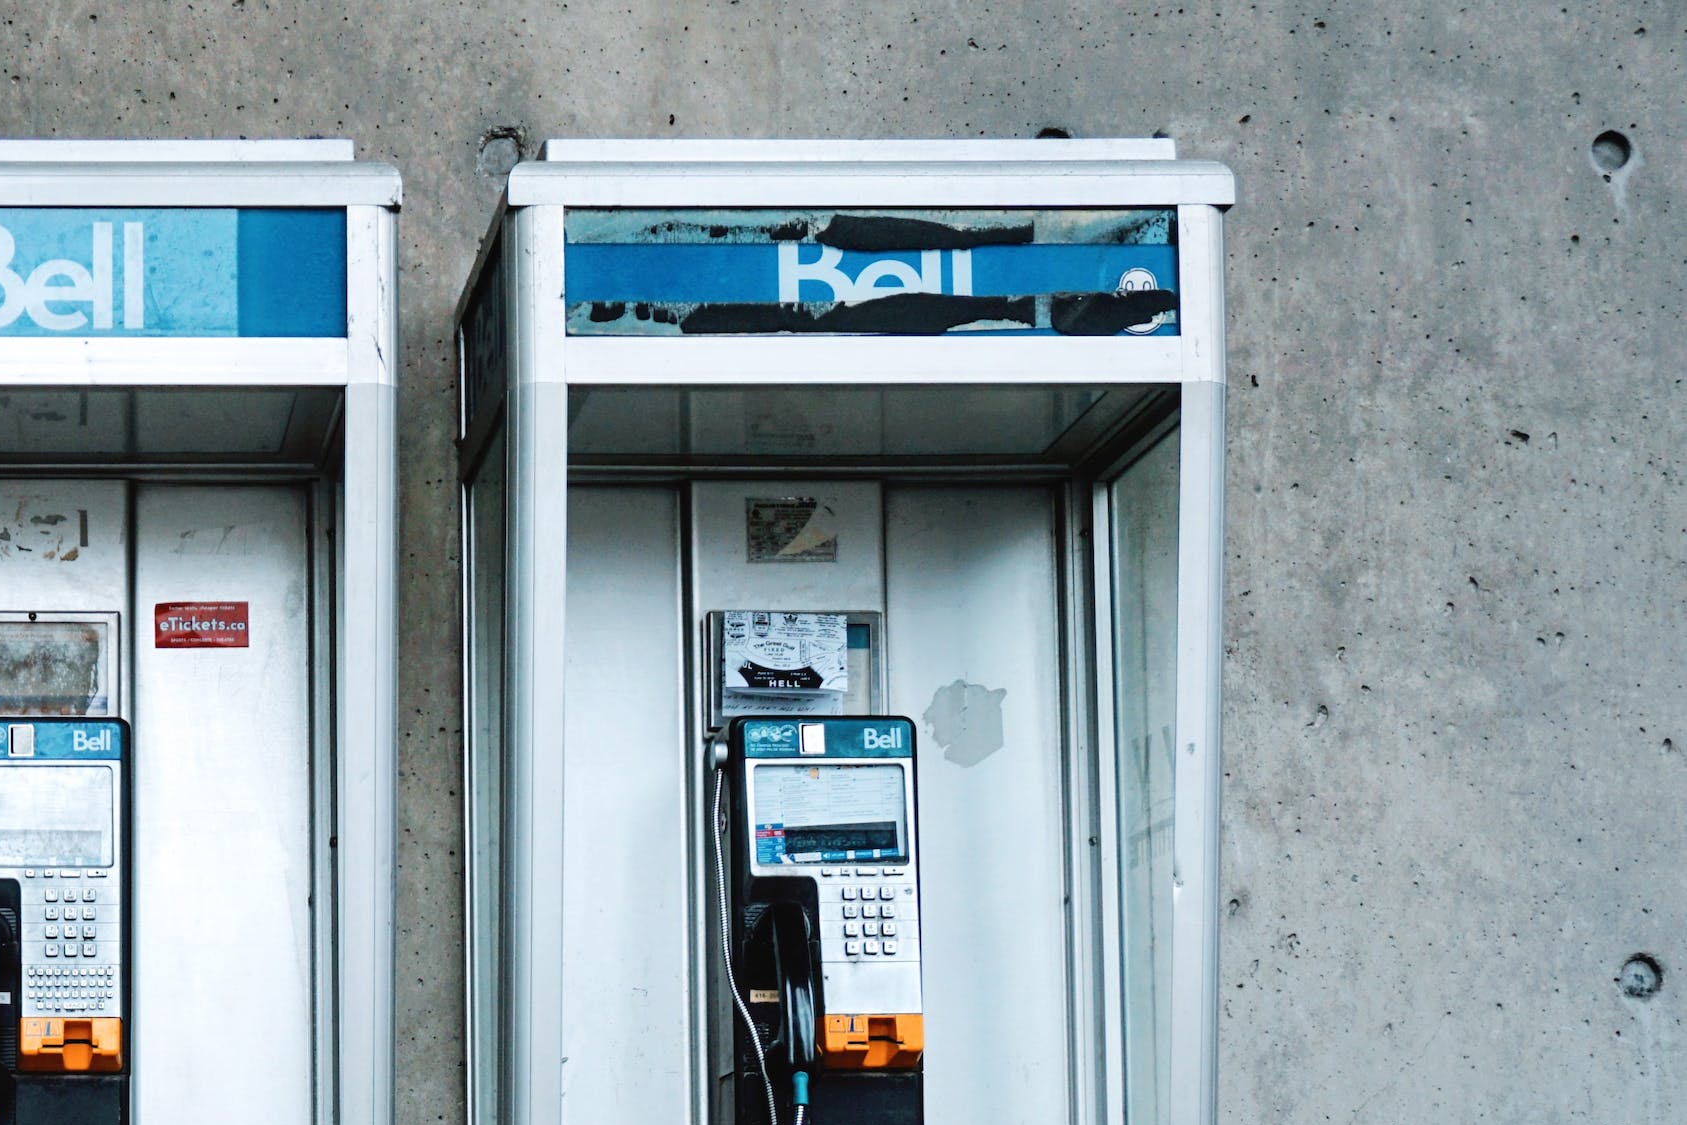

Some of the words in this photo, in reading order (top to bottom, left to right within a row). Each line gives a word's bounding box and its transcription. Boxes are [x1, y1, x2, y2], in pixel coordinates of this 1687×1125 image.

[160, 615, 246, 632] eTickets.ca
[769, 679, 801, 688] HELL
[73, 729, 112, 752] Bell
[863, 727, 902, 750] Bell
